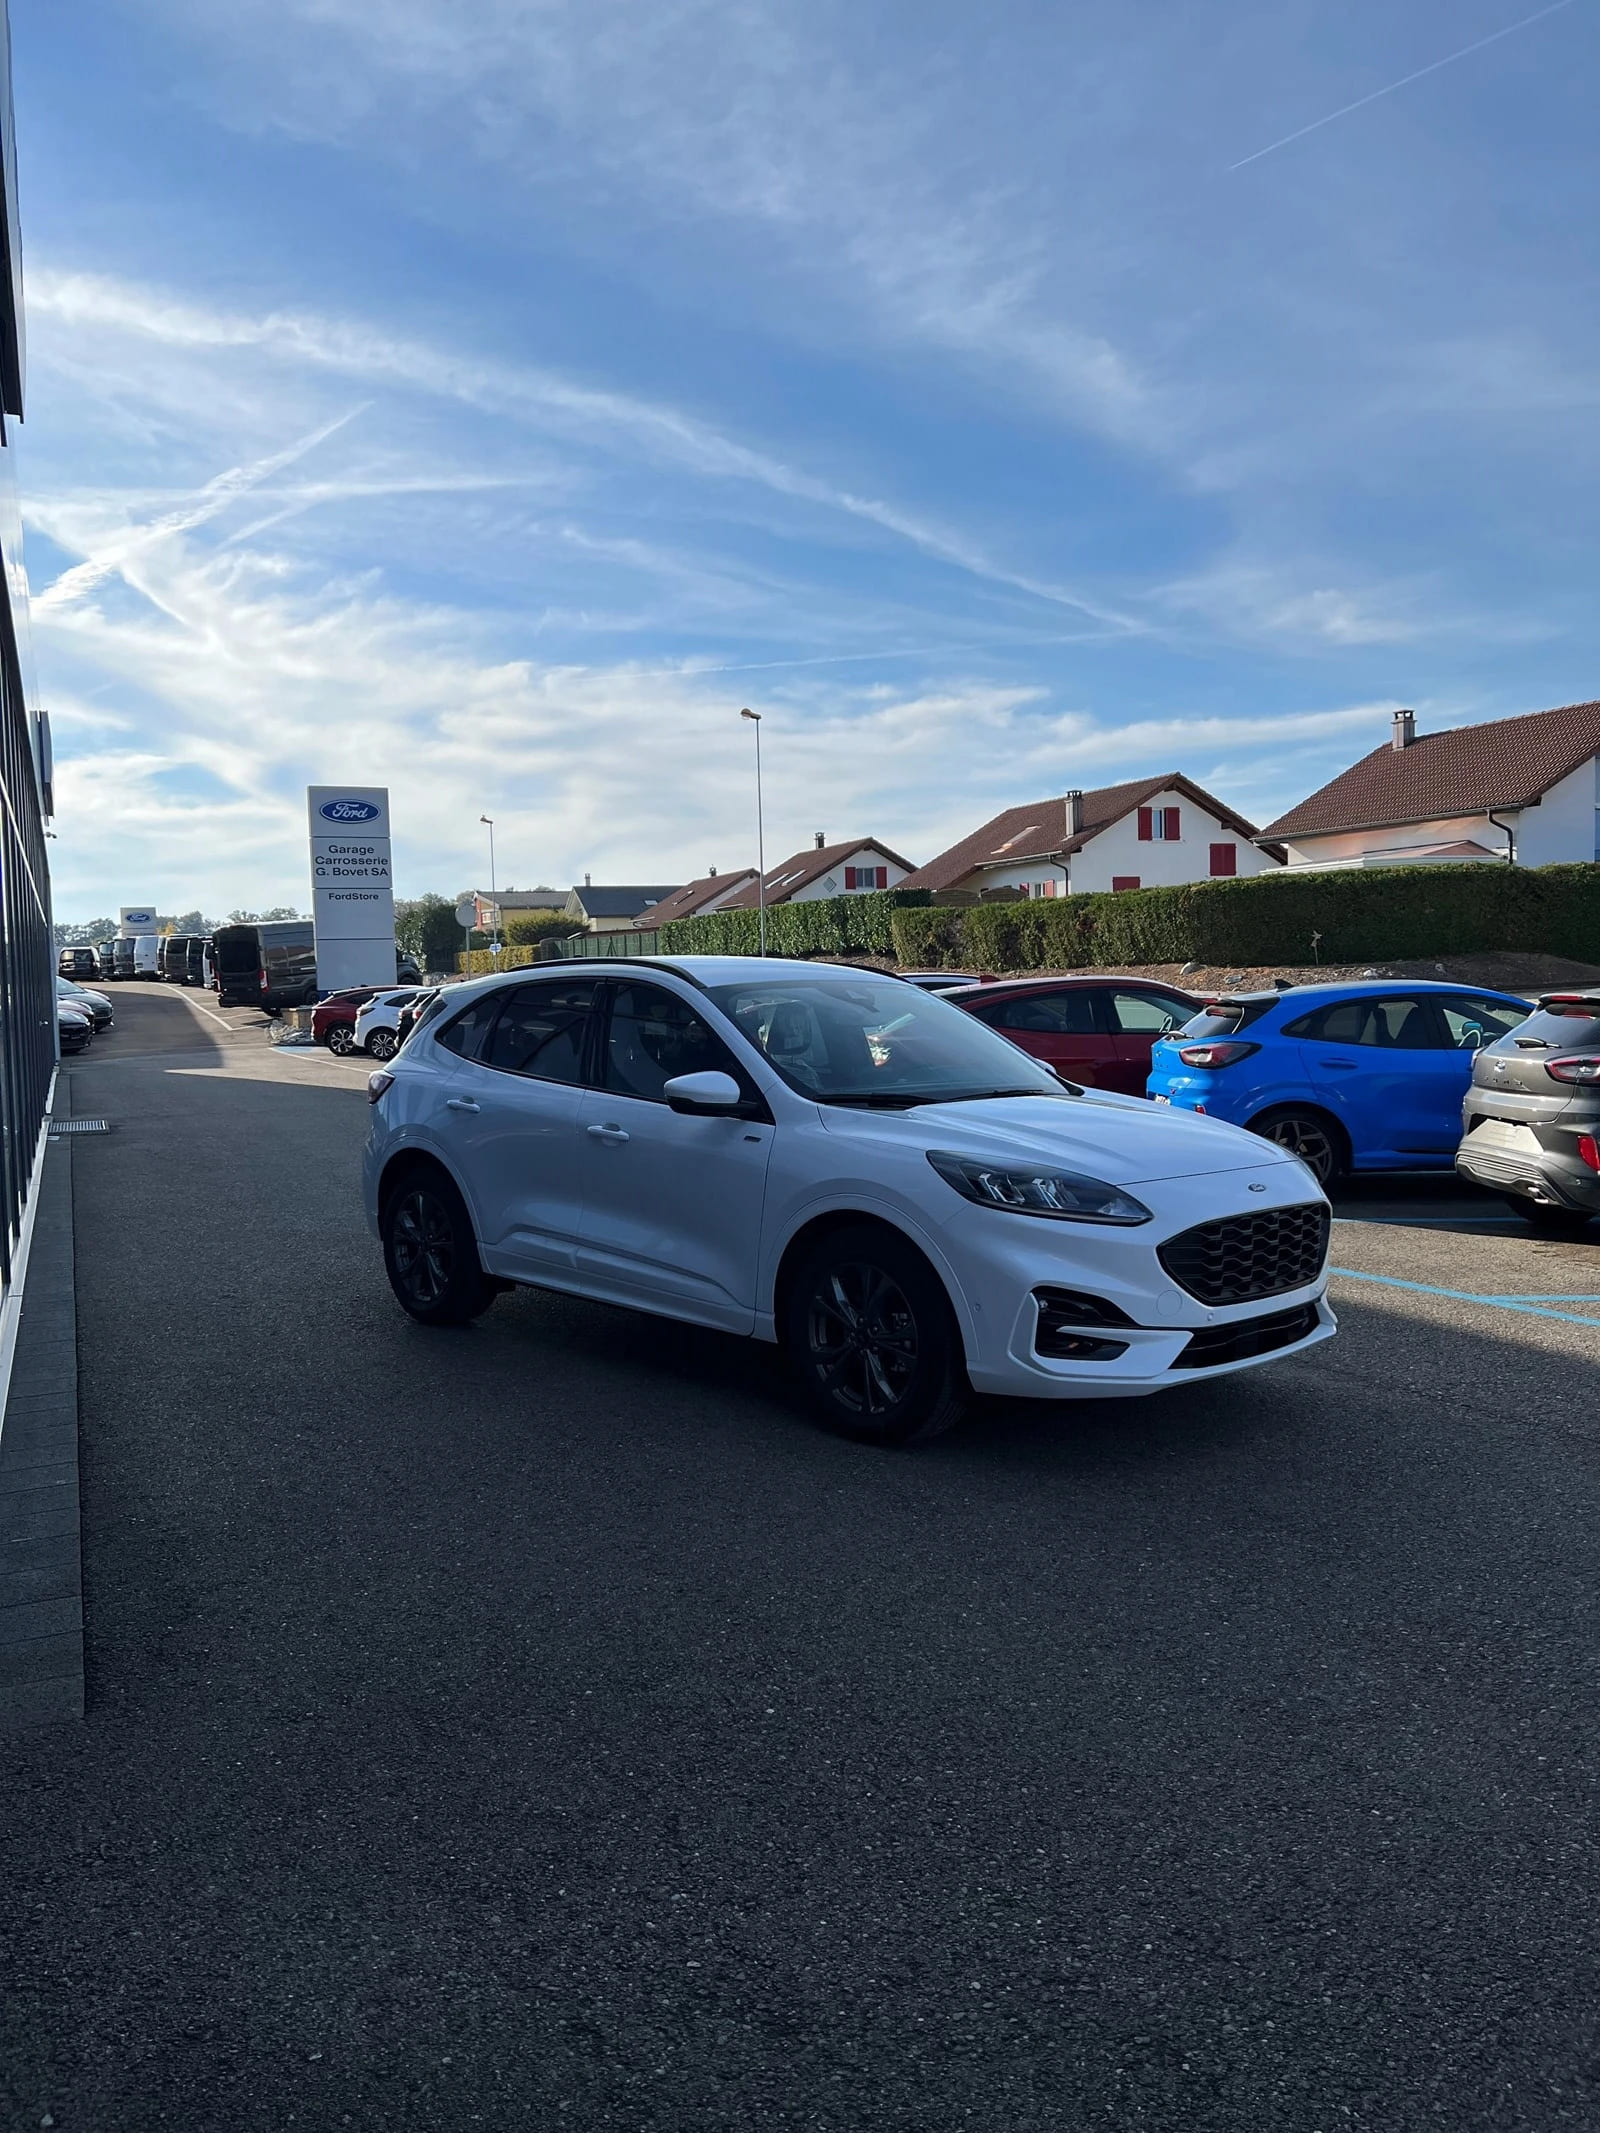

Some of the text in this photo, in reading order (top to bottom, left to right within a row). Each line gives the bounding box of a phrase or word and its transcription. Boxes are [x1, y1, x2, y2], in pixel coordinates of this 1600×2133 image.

[332, 802, 369, 818] Ford
[328, 844, 375, 856] Garage
[315, 855, 389, 865] Carrosserie
[315, 867, 389, 876] G. Bovet SA
[328, 892, 379, 901] FordStore
